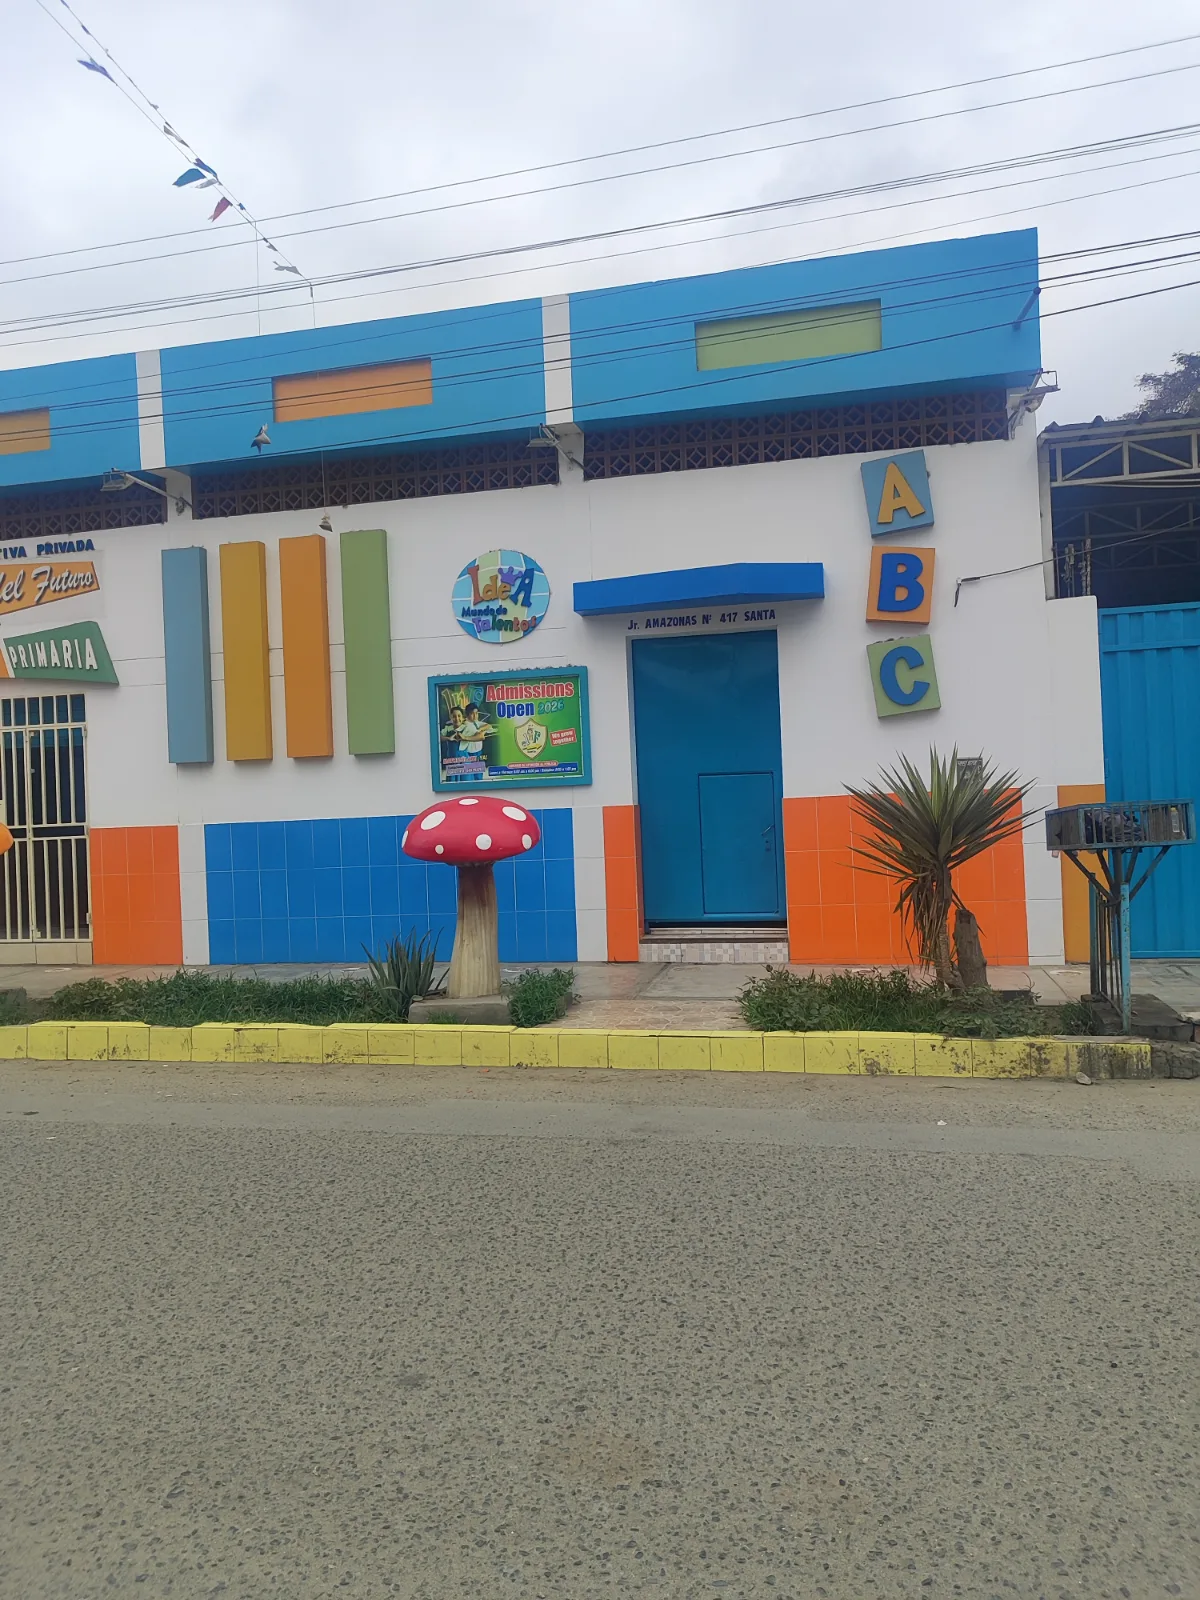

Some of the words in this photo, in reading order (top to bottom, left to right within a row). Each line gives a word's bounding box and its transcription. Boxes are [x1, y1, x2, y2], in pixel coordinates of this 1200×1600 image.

[877, 461, 926, 524] A
[37, 539, 95, 556] PRIVADA
[31, 566, 93, 604] Futuro
[877, 553, 925, 612] B
[462, 606, 496, 617] Mundo
[496, 605, 508, 615] de
[627, 619, 640, 630] Jr.
[645, 615, 697, 629] AMAZONAS
[720, 612, 738, 622] 417
[744, 609, 776, 622] SANTA
[472, 615, 537, 633] Talentos
[9, 638, 98, 669] PRIMARIA
[880, 646, 930, 706] C
[486, 682, 574, 702] Admissions
[496, 701, 535, 719] Open
[538, 700, 564, 715] 2026
